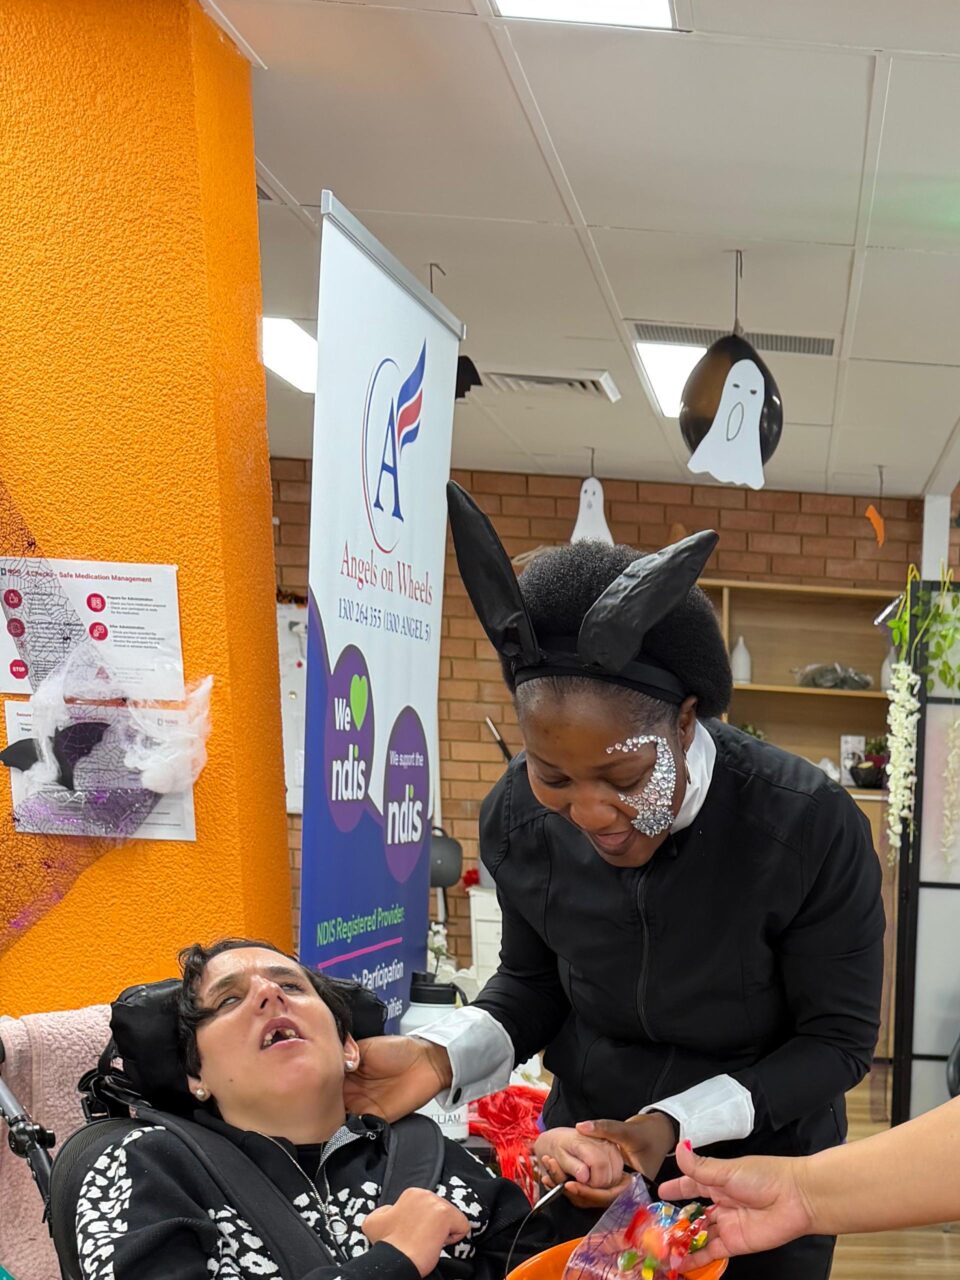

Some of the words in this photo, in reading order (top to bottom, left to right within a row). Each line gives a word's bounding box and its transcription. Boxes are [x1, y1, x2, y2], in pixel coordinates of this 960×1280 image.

[74, 572, 110, 581] Medication
[111, 574, 152, 583] Management
[340, 539, 378, 591] Angels
[380, 567, 393, 592] on
[397, 560, 432, 605] Wheels
[338, 597, 354, 621] 1300
[355, 602, 368, 626] 264
[370, 606, 381, 629] 355
[383, 608, 400, 633] (1300
[400, 615, 423, 640] ANGEL
[334, 697, 351, 731] We
[331, 744, 366, 801] ndis
[389, 750, 399, 766] We
[399, 752, 415, 770] support
[415, 752, 424, 767] the
[387, 784, 422, 845] ndis
[316, 919, 335, 947] NDIS
[336, 908, 376, 943] Registered
[362, 958, 404, 990] Participation
